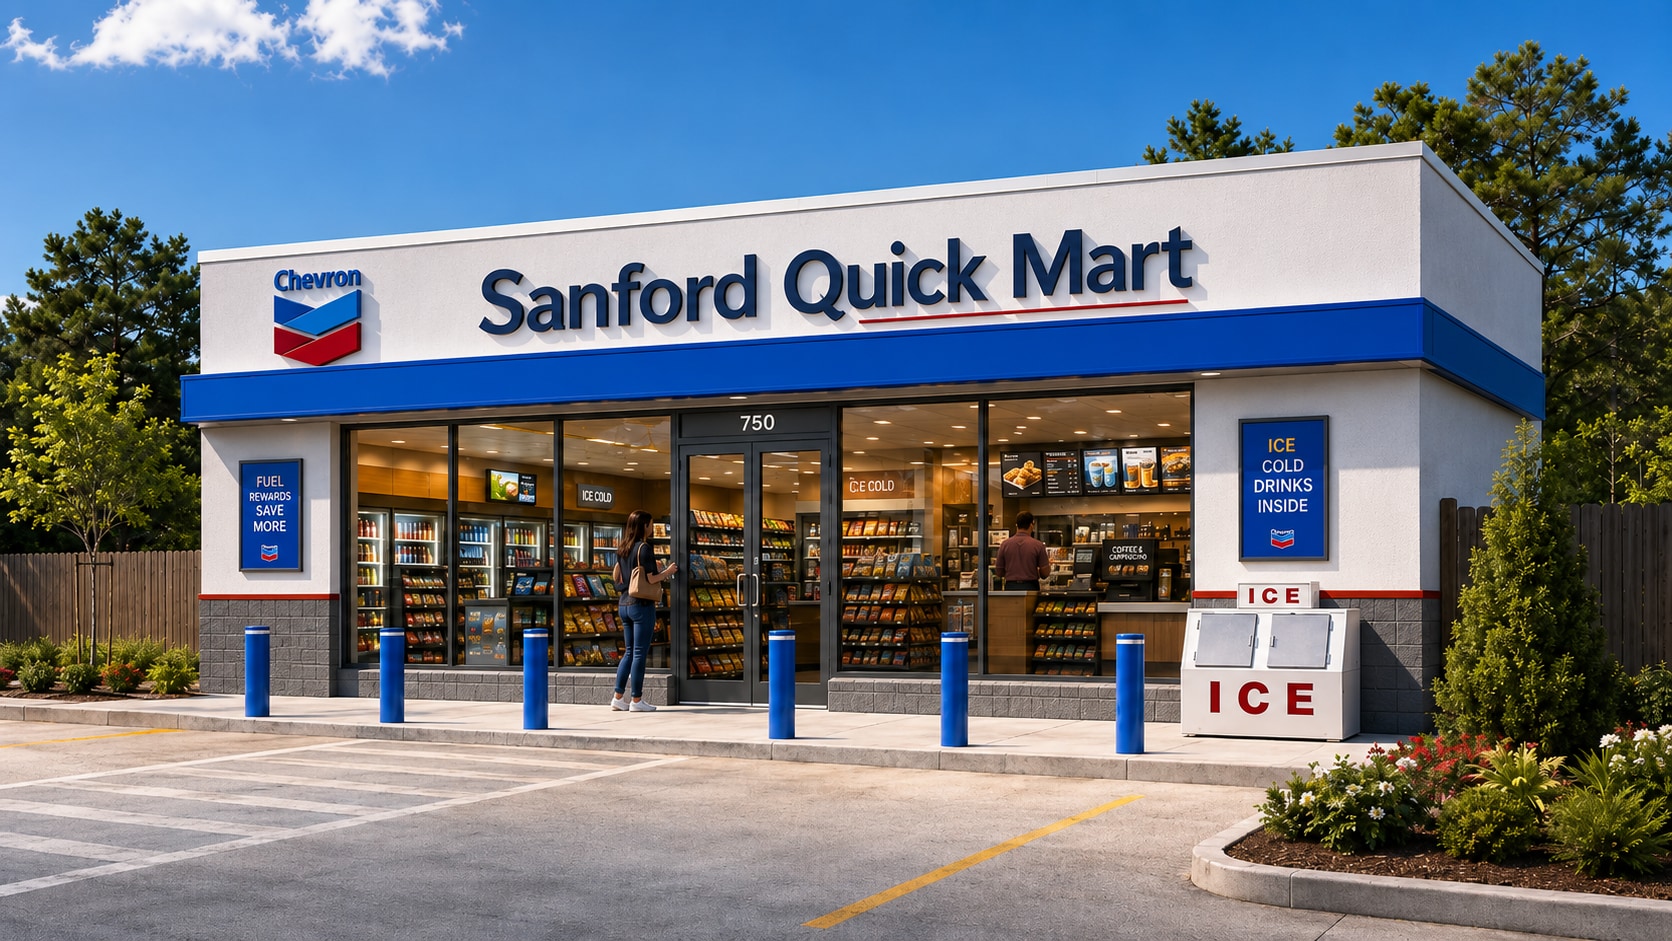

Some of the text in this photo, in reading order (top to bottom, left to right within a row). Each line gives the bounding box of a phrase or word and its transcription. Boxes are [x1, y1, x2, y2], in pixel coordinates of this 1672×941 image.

[273, 268, 362, 292] Chevron
[478, 226, 1193, 336] Sanford Quick Mart
[740, 414, 775, 431] 750
[1268, 437, 1296, 453] ICE
[1262, 458, 1304, 473] COLD
[256, 475, 285, 488] FUEL
[868, 480, 895, 492] COLD
[1254, 477, 1313, 493] DRINKS
[249, 491, 292, 502] REWARDS
[582, 489, 594, 501] ICE
[256, 504, 284, 517] SAVE
[1258, 498, 1309, 513] INSIDE
[253, 520, 287, 532] MORE
[1248, 587, 1300, 604] ICE
[1210, 680, 1314, 716] ICE
